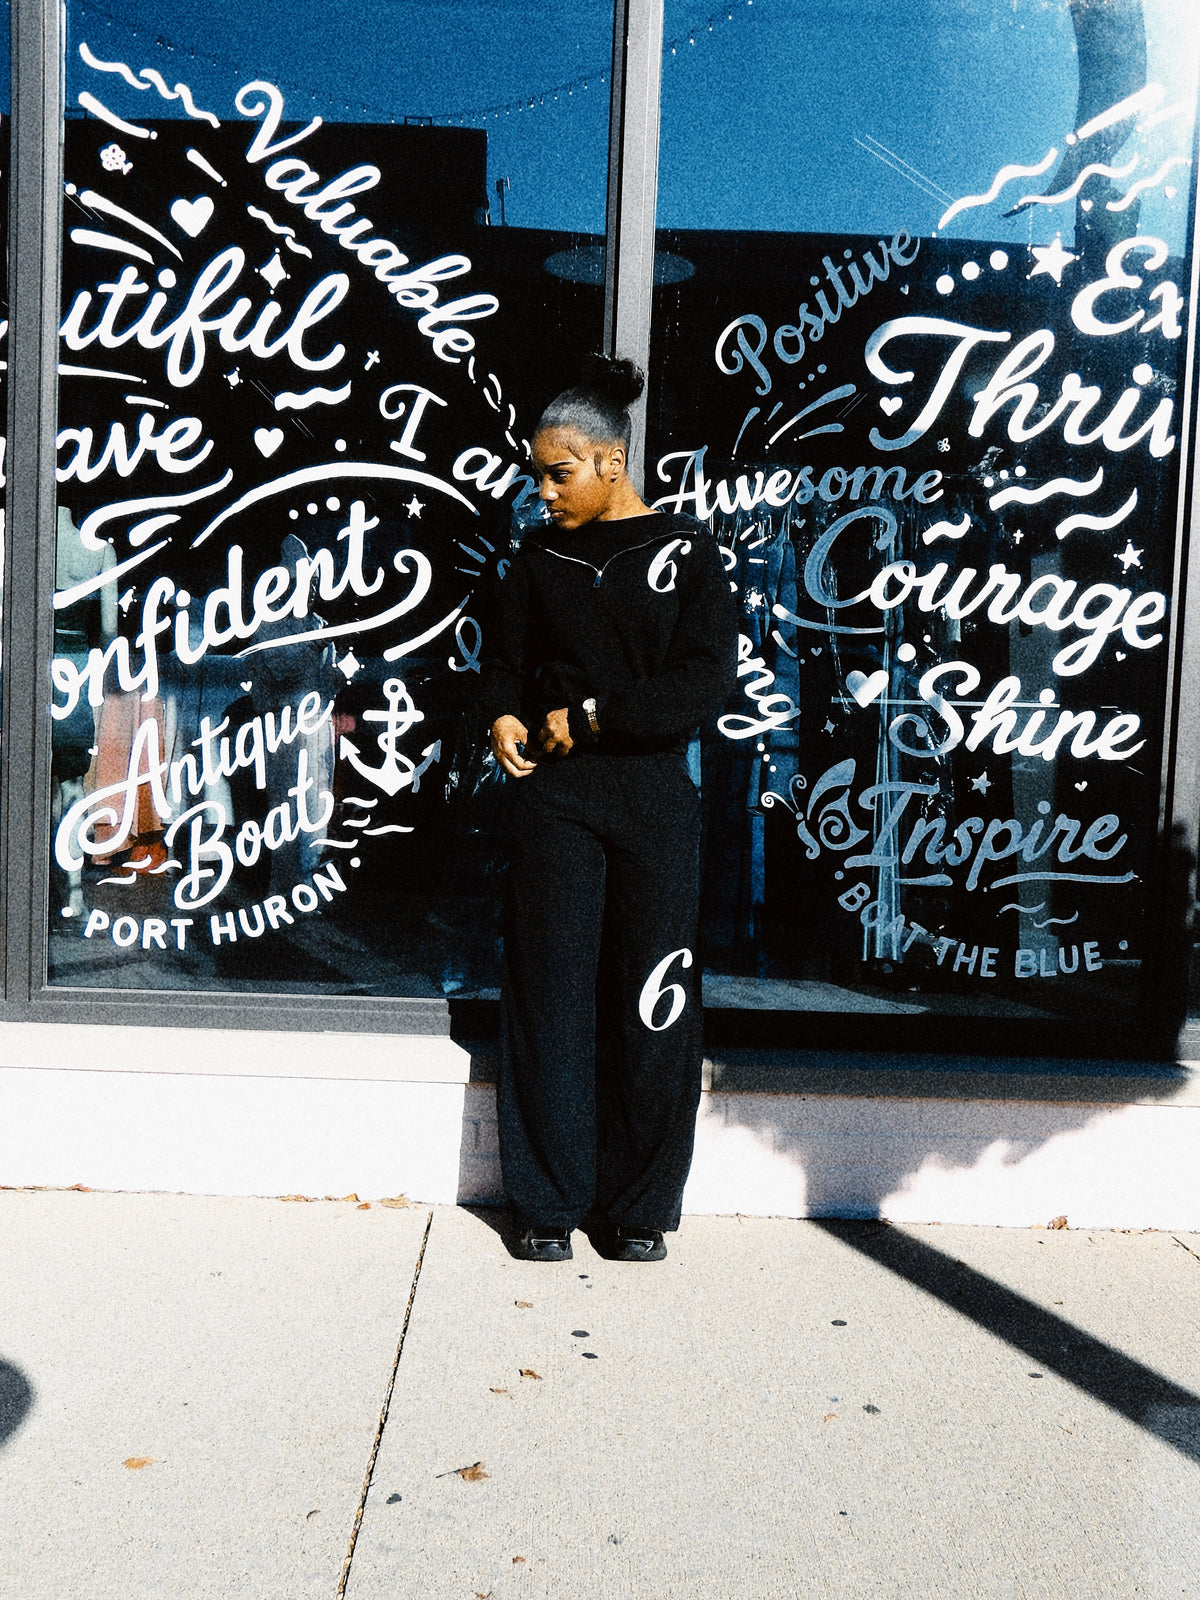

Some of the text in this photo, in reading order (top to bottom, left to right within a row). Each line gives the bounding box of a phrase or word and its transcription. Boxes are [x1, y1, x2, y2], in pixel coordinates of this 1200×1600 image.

[234, 80, 499, 364] Valuable
[714, 227, 921, 395] Positive
[379, 384, 448, 461] I
[650, 445, 944, 520] Awesome
[50, 500, 388, 720] onfident
[647, 538, 692, 593] 6
[804, 506, 1166, 678] Courage
[888, 660, 1147, 762] Shine
[55, 691, 335, 872] Antique
[164, 748, 335, 909] Boat
[843, 781, 1129, 891] Inspire
[84, 863, 347, 949] PORT HURON
[934, 935, 1000, 978] THE
[1014, 940, 1103, 979] BLUE
[638, 947, 693, 1032] 6
